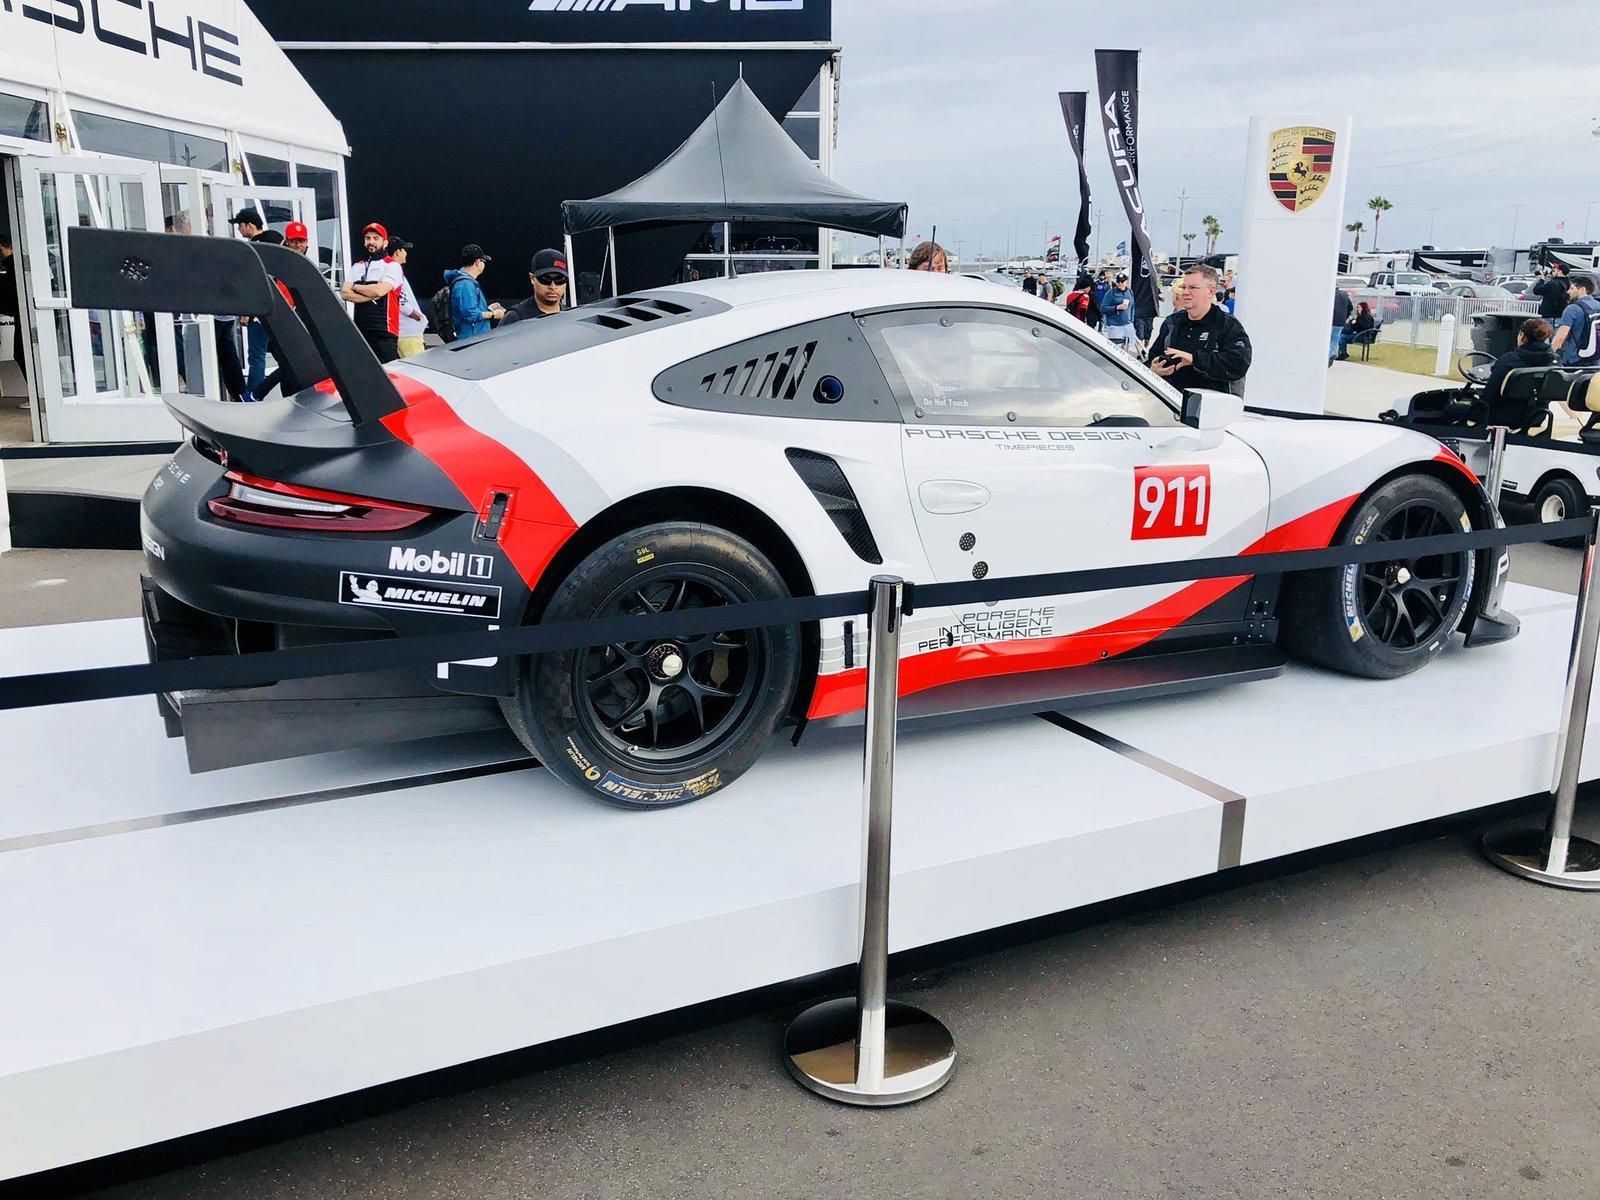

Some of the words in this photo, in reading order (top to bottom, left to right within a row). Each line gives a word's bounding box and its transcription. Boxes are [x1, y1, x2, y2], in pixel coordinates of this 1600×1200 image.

[933, 383, 957, 392] Please
[923, 398, 933, 406] Do
[934, 398, 946, 407] Not
[948, 399, 969, 407] Touch
[904, 428, 1042, 441] PORSCHE
[1049, 431, 1142, 441] DESIGN
[996, 443, 1076, 451] TIMEPIECES
[1139, 475, 1206, 528] 911
[388, 547, 466, 577] Mobil
[384, 587, 487, 607] MICHELIN
[962, 606, 1056, 622] PORSCHE
[938, 616, 1054, 637] INTELLIGENT
